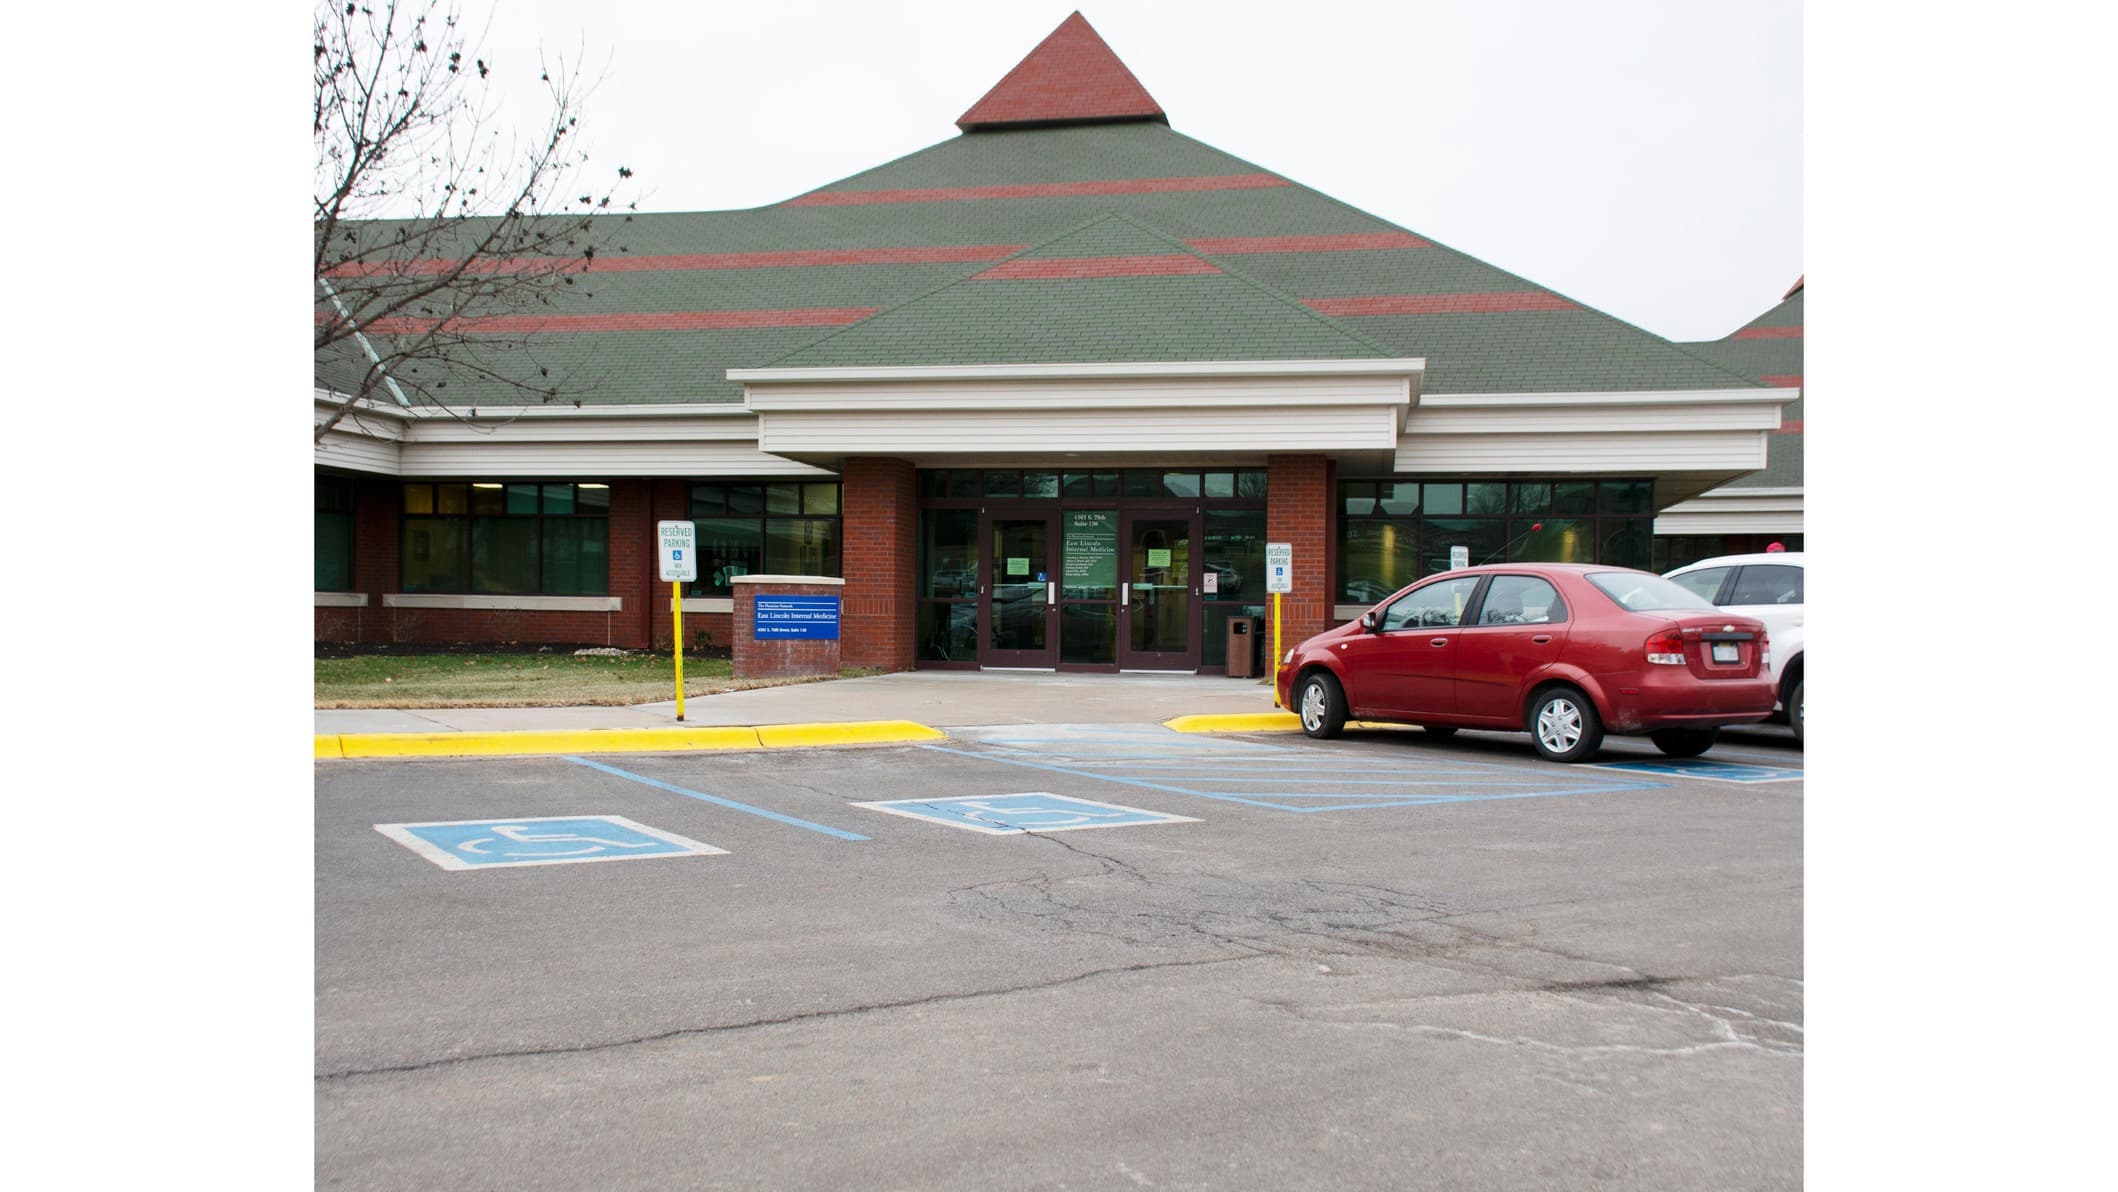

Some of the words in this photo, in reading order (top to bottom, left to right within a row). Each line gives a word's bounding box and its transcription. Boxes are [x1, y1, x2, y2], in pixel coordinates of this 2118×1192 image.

[661, 527, 692, 537] RESERVED
[664, 538, 690, 548] PARKING
[1268, 548, 1290, 556] RESERVED
[1270, 557, 1288, 565] PARKING
